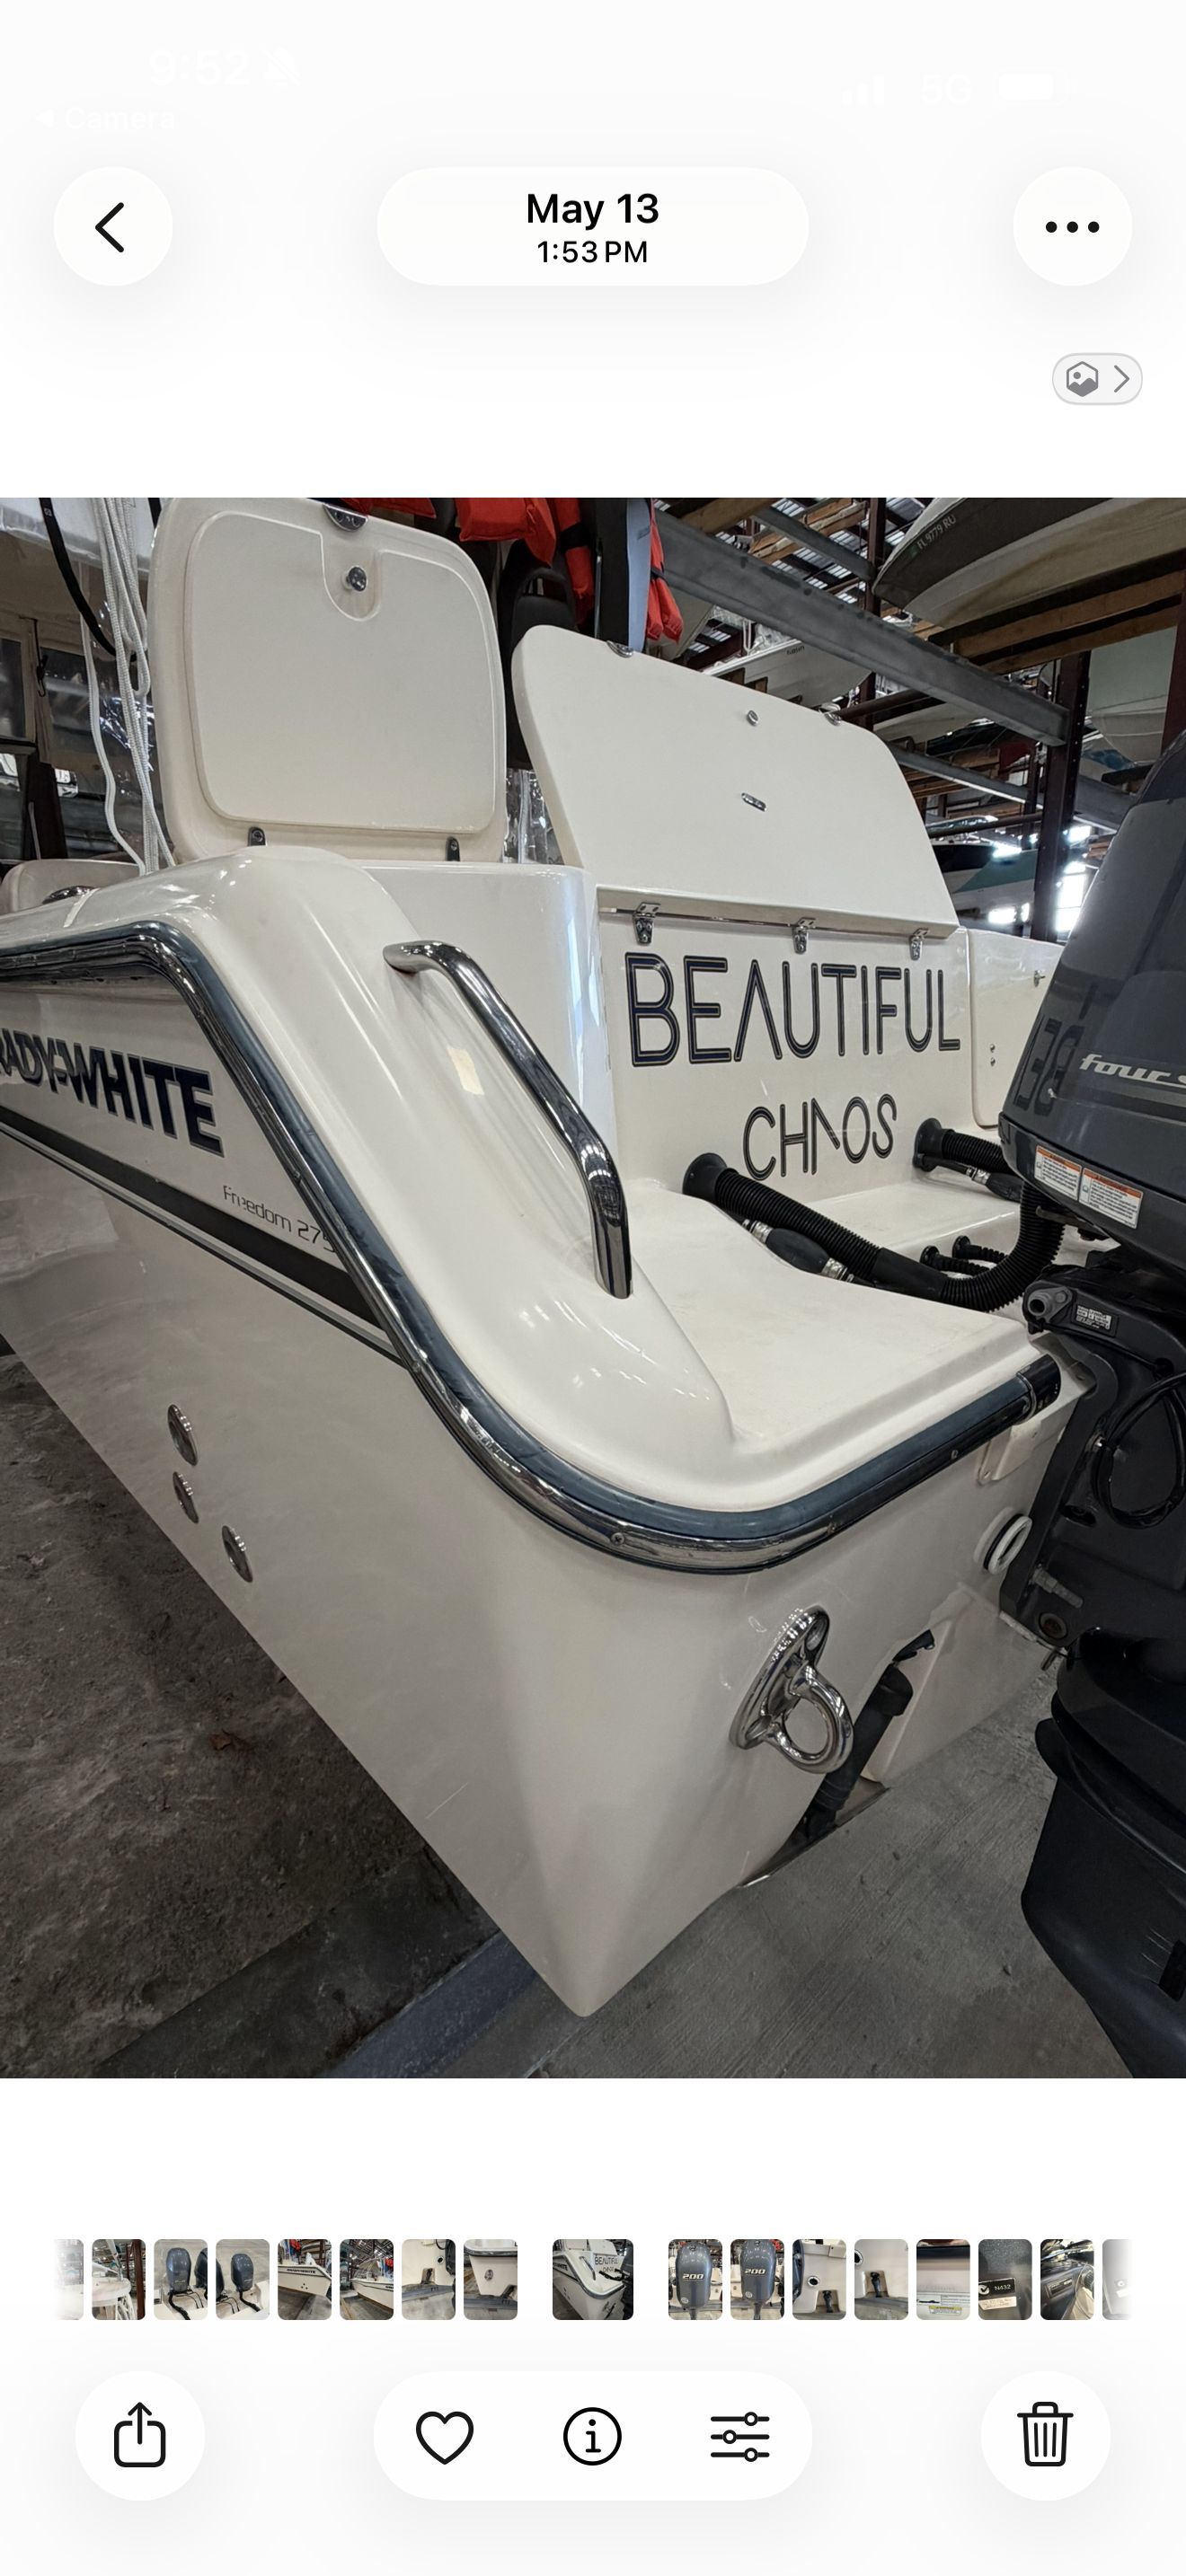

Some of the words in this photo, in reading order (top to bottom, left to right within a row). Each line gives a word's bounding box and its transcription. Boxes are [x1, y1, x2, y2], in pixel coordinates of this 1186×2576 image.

[916, 539, 928, 550] FL
[943, 514, 957, 528] RU
[624, 951, 961, 1067] BEAUTIFUL
[743, 1093, 898, 1181] CHAOS
[223, 1185, 292, 1233] Freedom
[994, 2283, 1012, 2291] N432
